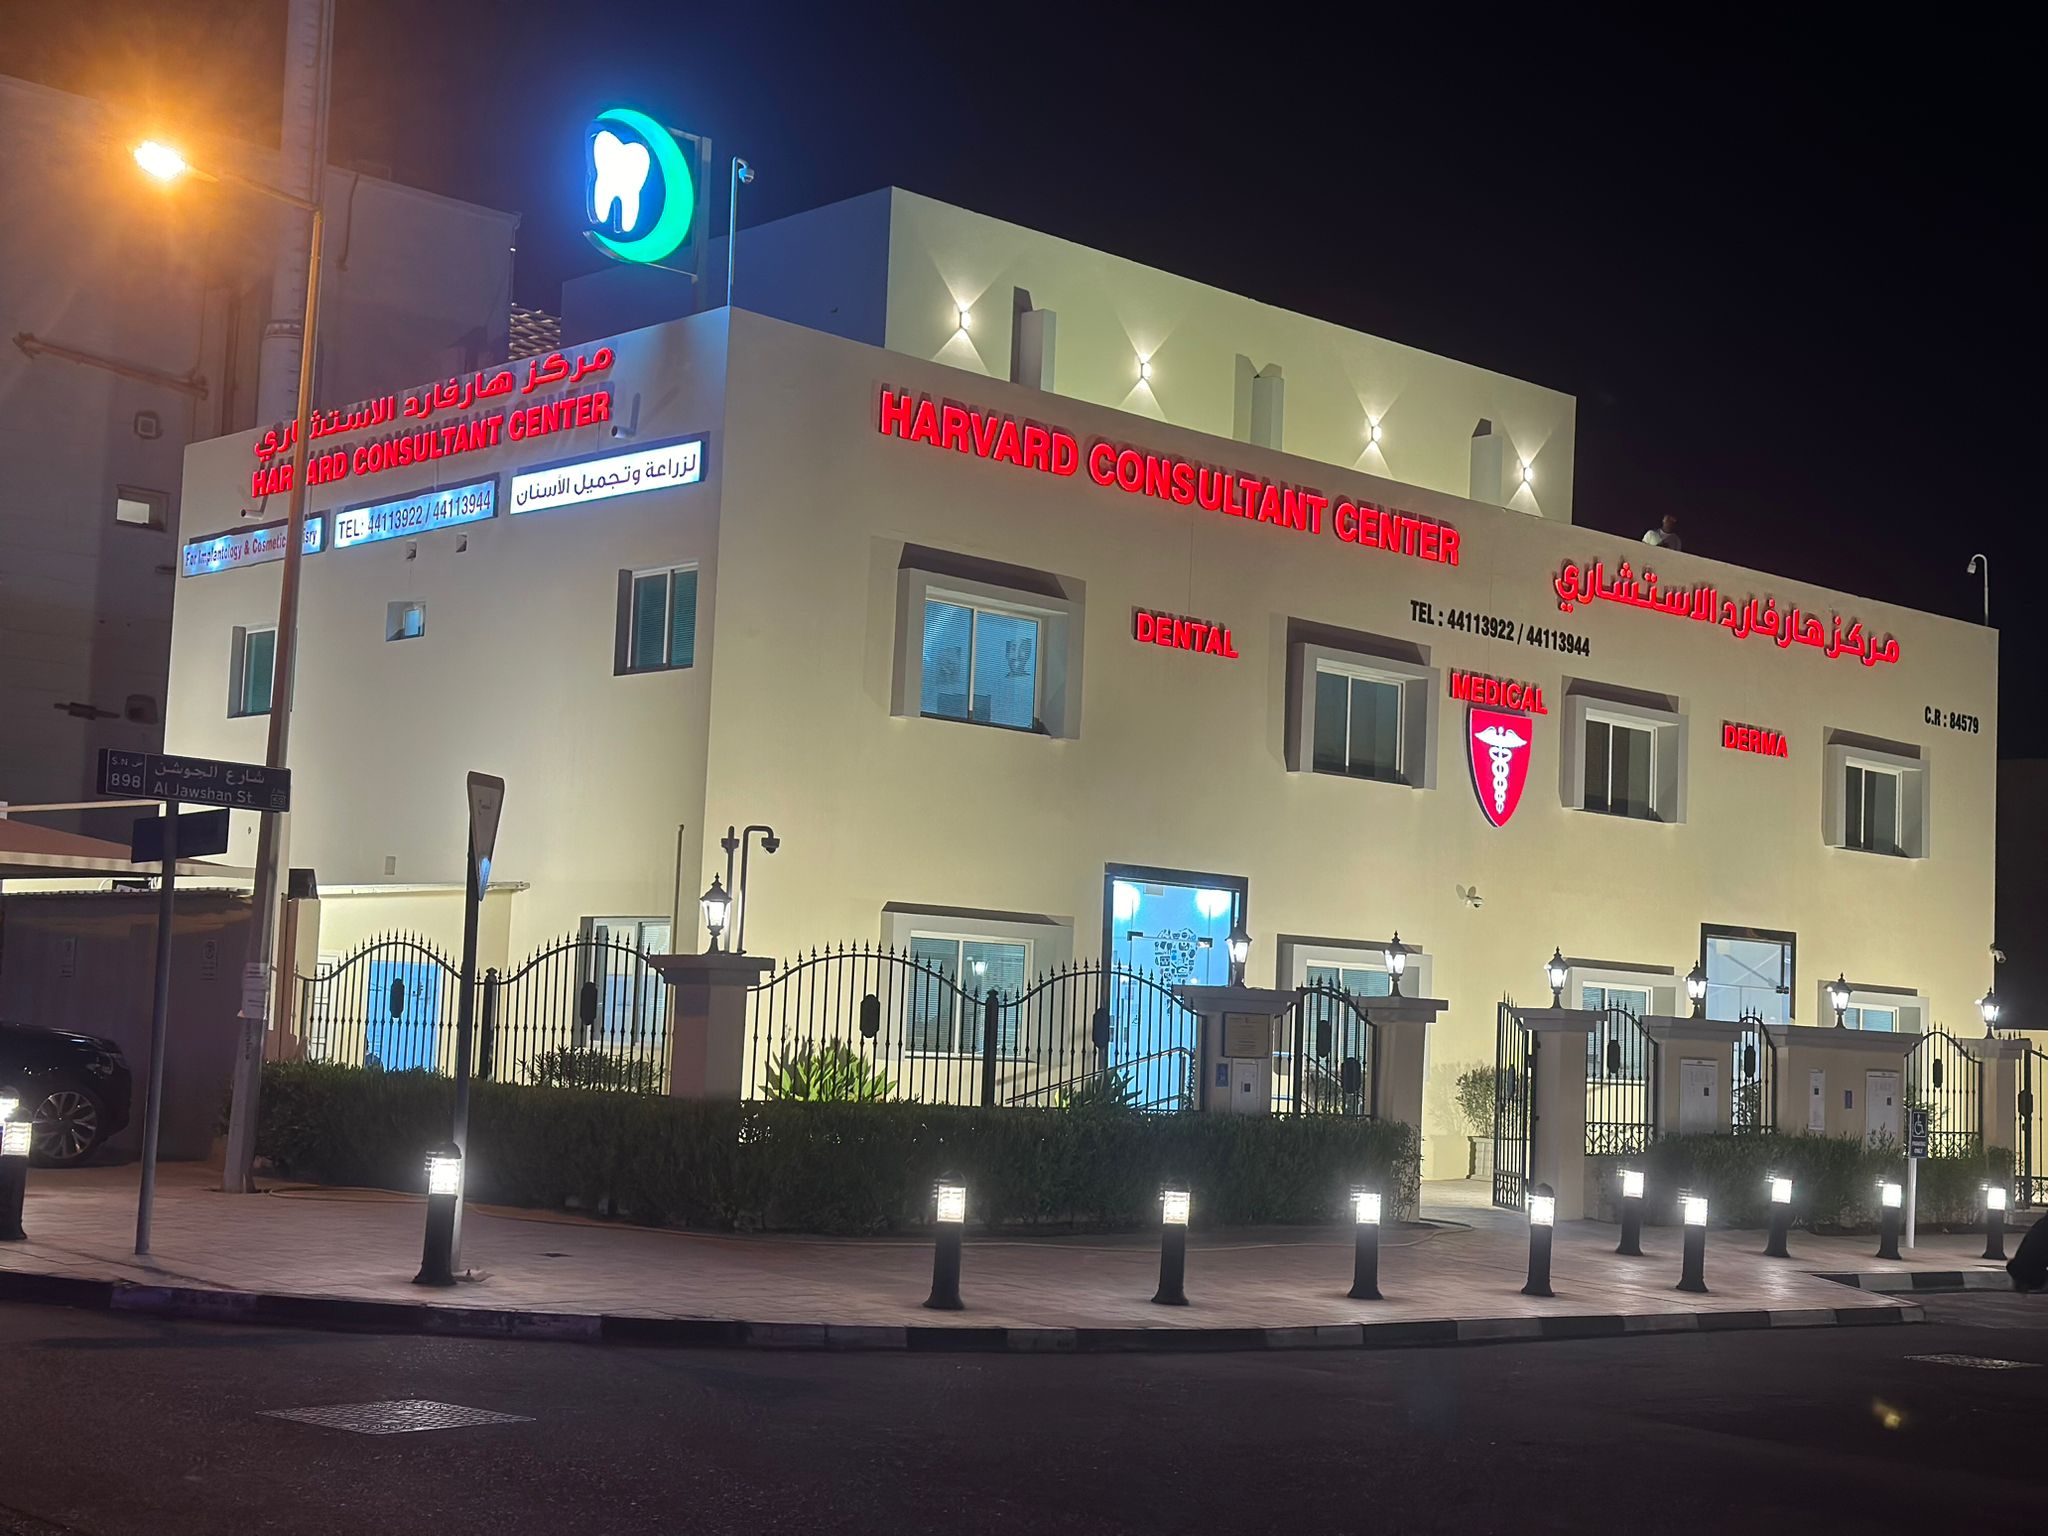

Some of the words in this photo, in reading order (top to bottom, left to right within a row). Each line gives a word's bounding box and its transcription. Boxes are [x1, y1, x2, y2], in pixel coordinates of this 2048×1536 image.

[521, 347, 613, 394] مركز
[404, 371, 513, 419] هارفارد
[252, 452, 348, 498] HARARD
[353, 415, 503, 475] CONSULTANT
[508, 391, 610, 441] CENTER
[574, 466, 641, 495] وتجميل
[645, 454, 696, 478] لزراعة
[881, 390, 1079, 476] HARVARD
[1089, 443, 1328, 534] CONSULTANT
[1335, 502, 1461, 566] CENTER
[516, 474, 570, 506] الأسنان
[368, 505, 423, 534] 44113922
[433, 490, 491, 521] 44113944
[185, 551, 198, 566] For
[244, 541, 250, 555] &
[252, 532, 287, 553] Cosmetic
[1555, 561, 1717, 623] الاستشاري
[1137, 612, 1239, 658] DENTAL
[1447, 608, 1514, 641] 44113922
[1526, 625, 1590, 656] 44113944
[1721, 598, 1825, 648] هارفارد
[1826, 616, 1900, 666] مركز
[1451, 672, 1548, 714] MEDICAL
[1724, 724, 1788, 758] DERMA
[1949, 712, 1979, 734] 84579
[111, 773, 141, 788] 898
[154, 762, 218, 779] الجوشن
[225, 770, 264, 785] شارع
[154, 781, 168, 795] Al
[174, 784, 232, 801] Jawshan
[237, 790, 256, 804] St.
